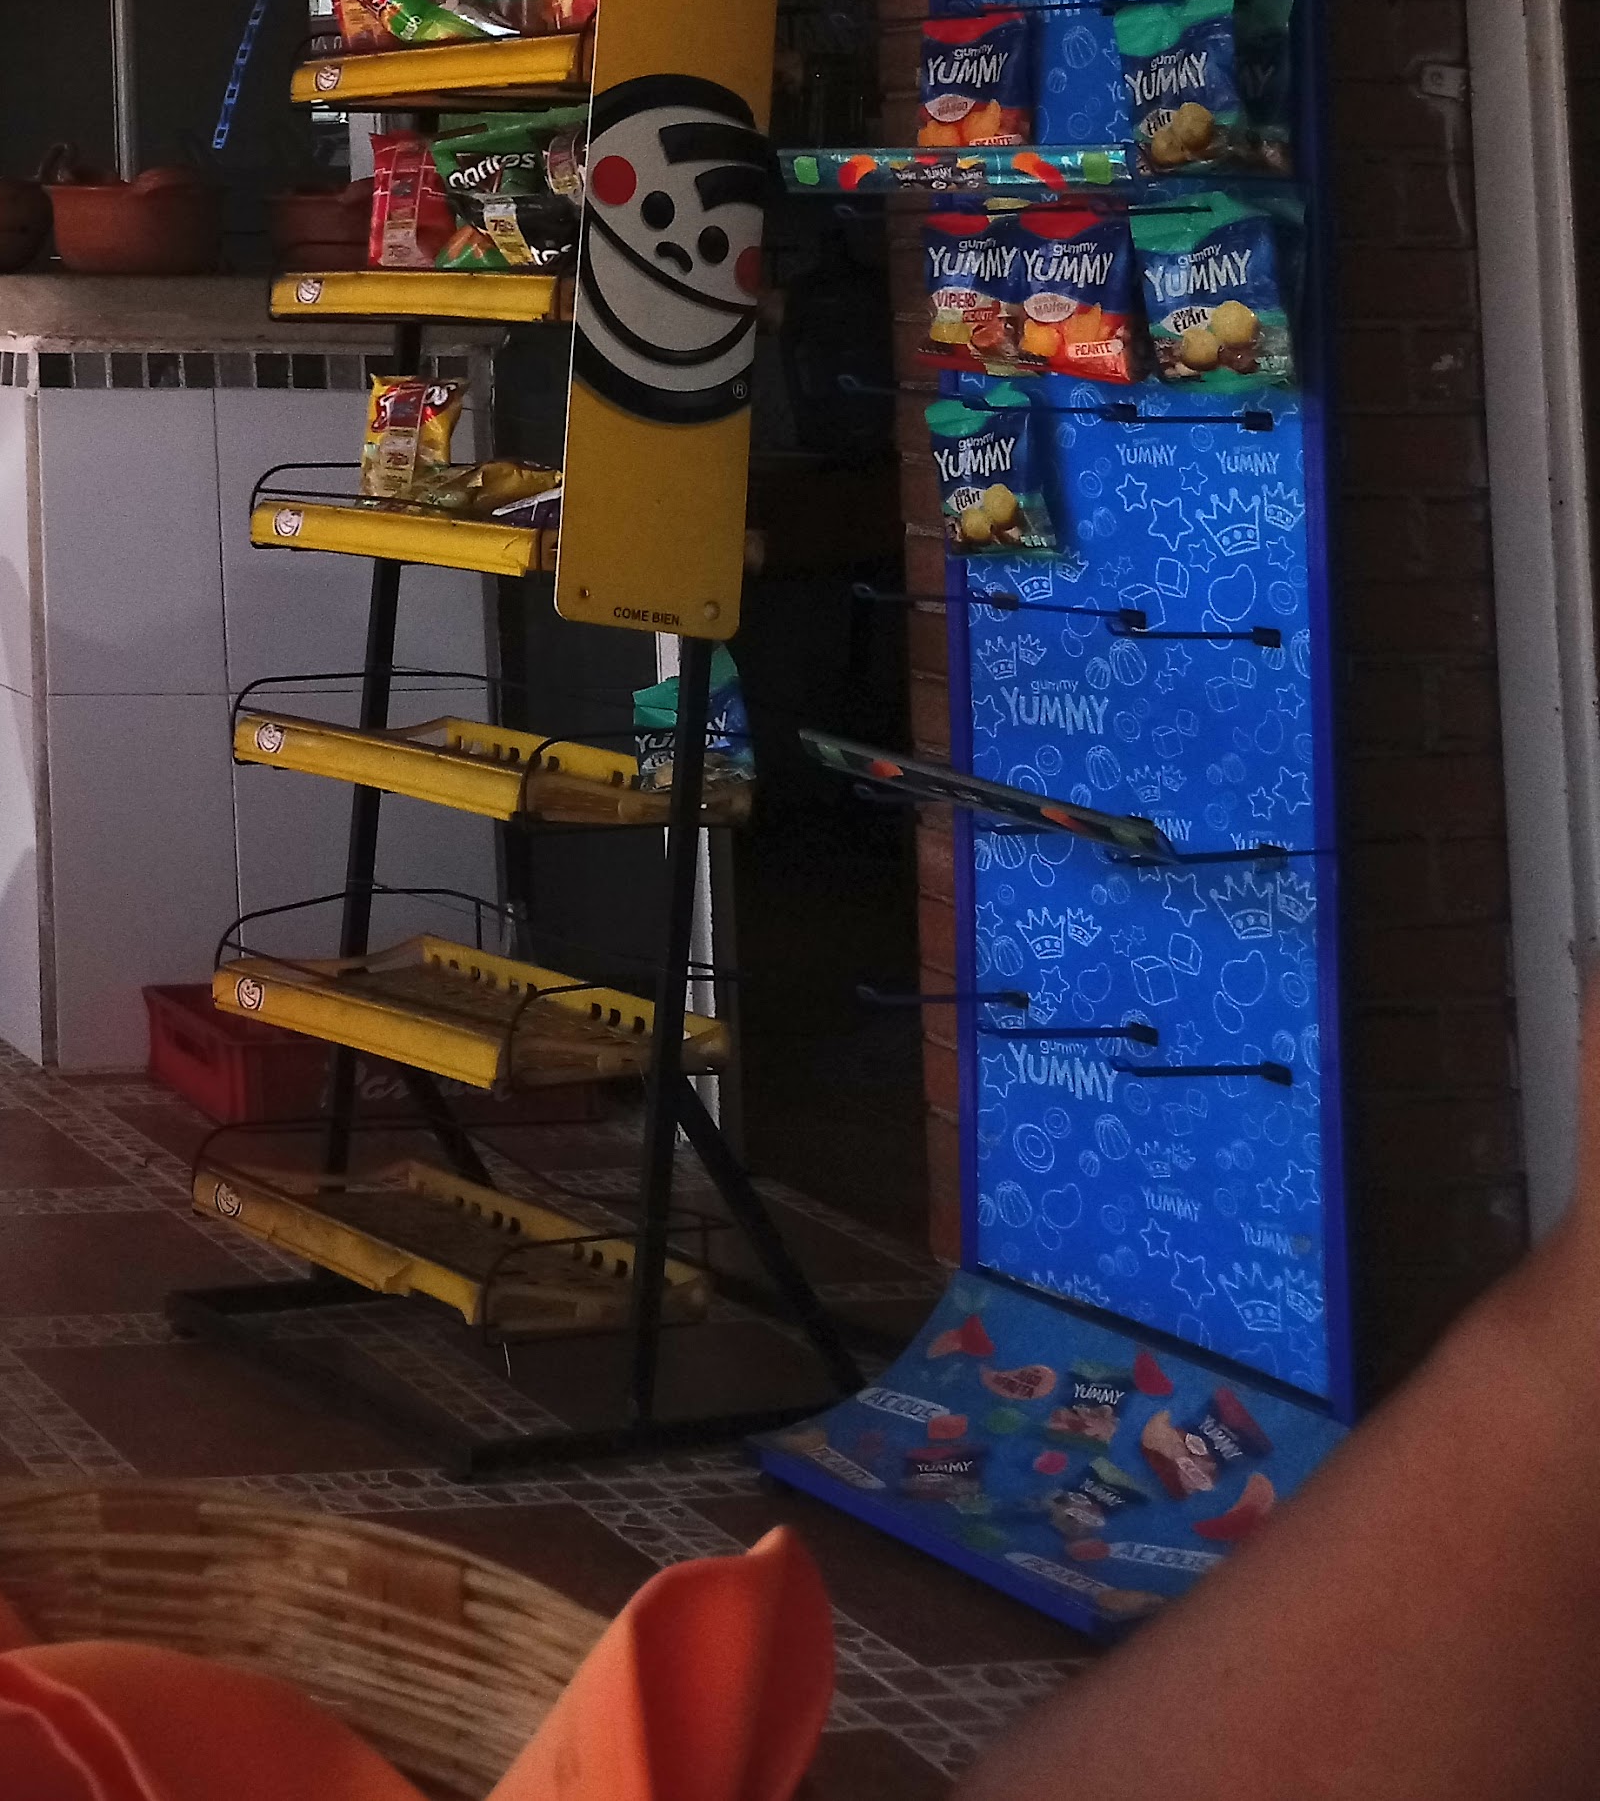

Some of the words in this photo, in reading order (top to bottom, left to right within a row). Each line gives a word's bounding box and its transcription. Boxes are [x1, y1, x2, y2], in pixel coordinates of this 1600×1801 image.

[926, 51, 1009, 89] YUMMY
[927, 243, 1019, 282] YUMMY
[1052, 240, 1098, 257] gummy
[1177, 242, 1223, 268] gummy
[1022, 248, 1115, 289] YUMMY
[1143, 246, 1253, 304] YUMMY
[932, 435, 1016, 485] YUMMY
[1114, 442, 1178, 468] YUMMY
[1214, 451, 1280, 476] YUMMY
[613, 605, 649, 624] COME
[651, 610, 684, 628] BIEN.
[1030, 677, 1080, 694] gummy
[1000, 685, 1110, 737] YUMMY
[1039, 1038, 1089, 1056] gummy
[1008, 1039, 1120, 1103] YUMMY
[1142, 1186, 1202, 1222] YUMMY
[1240, 1222, 1297, 1258] YUMM
[1073, 1382, 1126, 1406] YUMMY
[916, 1459, 973, 1475] YUMMY
